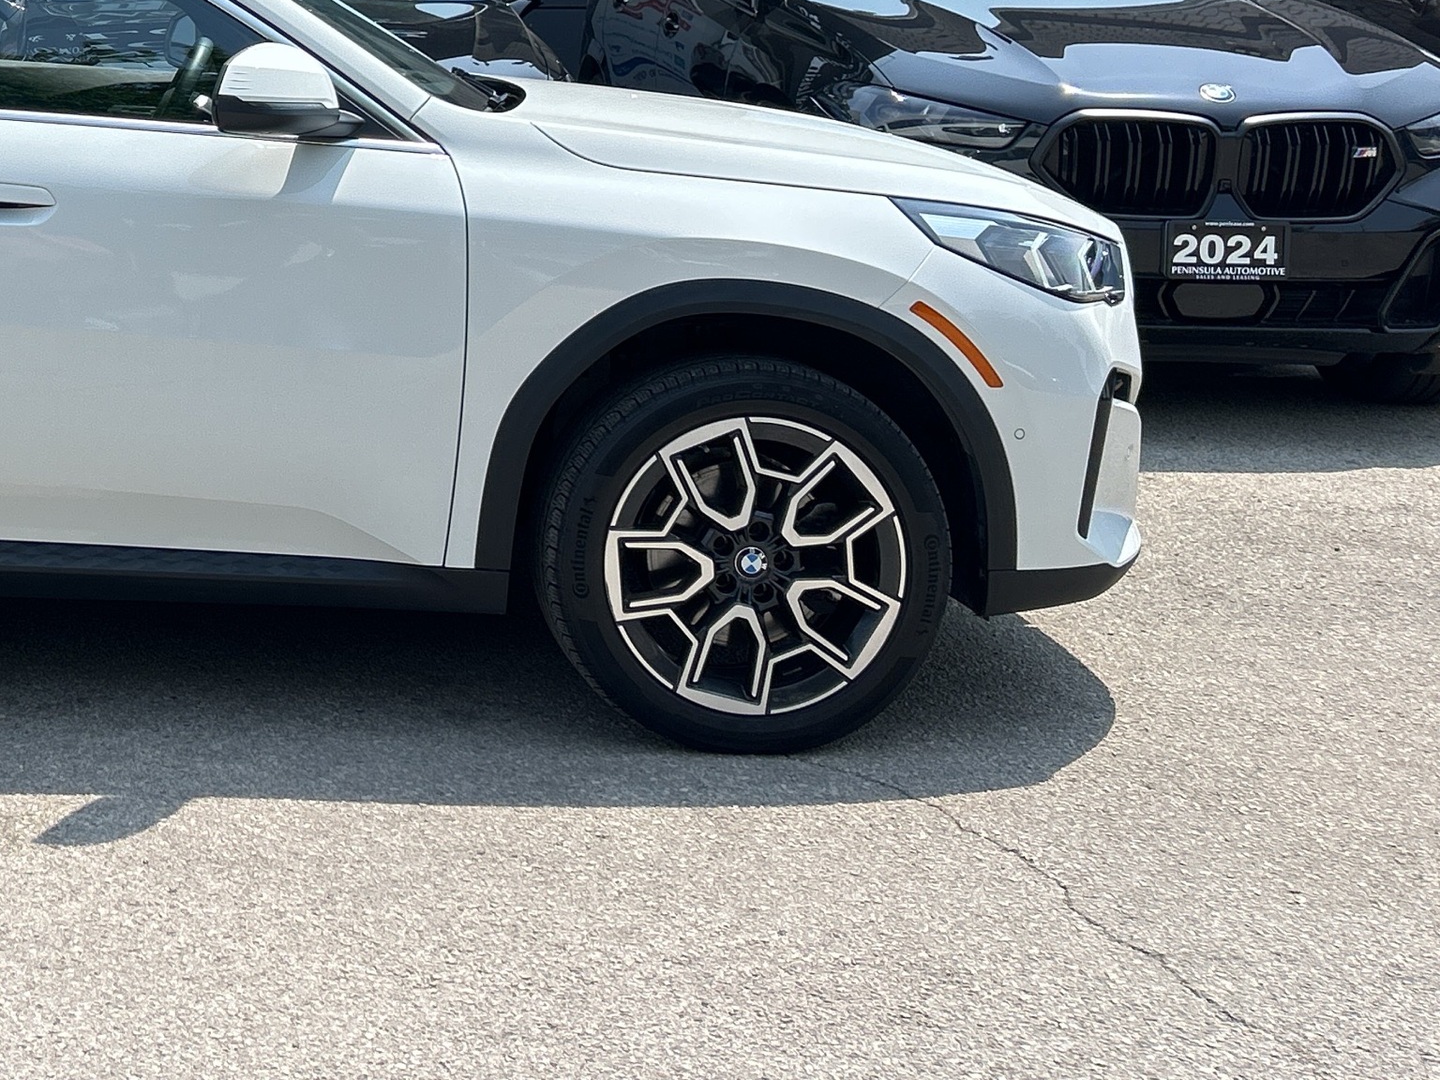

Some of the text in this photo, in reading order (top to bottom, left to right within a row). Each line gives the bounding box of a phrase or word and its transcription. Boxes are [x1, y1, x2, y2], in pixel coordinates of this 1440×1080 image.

[1171, 265, 1286, 276] PENINSULA AUTOMOTIVE
[1172, 233, 1278, 265] 2024
[570, 506, 595, 599] Continental
[919, 533, 942, 625] Continental
